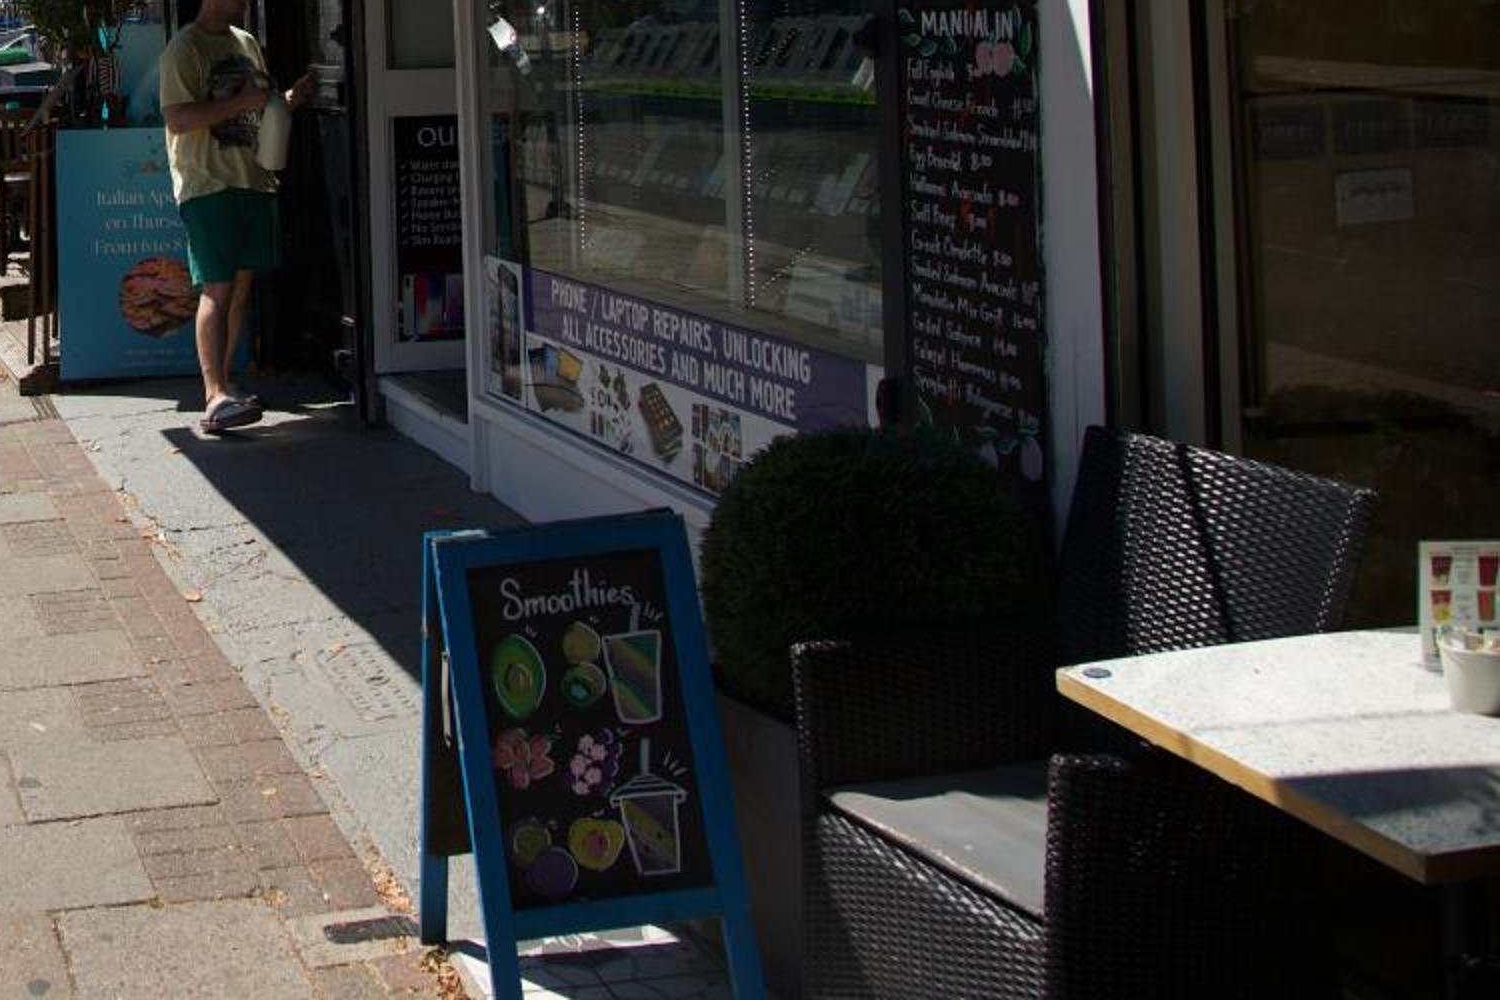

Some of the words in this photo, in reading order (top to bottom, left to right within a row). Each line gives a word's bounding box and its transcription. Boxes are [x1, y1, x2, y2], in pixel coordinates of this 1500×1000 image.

[550, 279, 588, 314] PHONE
[600, 289, 649, 331] LAPTOP
[722, 328, 812, 385] UNLOCKING
[562, 316, 583, 345] ALL
[586, 323, 668, 374] ACCESSORIES
[671, 352, 700, 385] AND
[703, 361, 746, 400] MUCH
[751, 376, 797, 422] MORE
[500, 566, 636, 621] Smoothies
